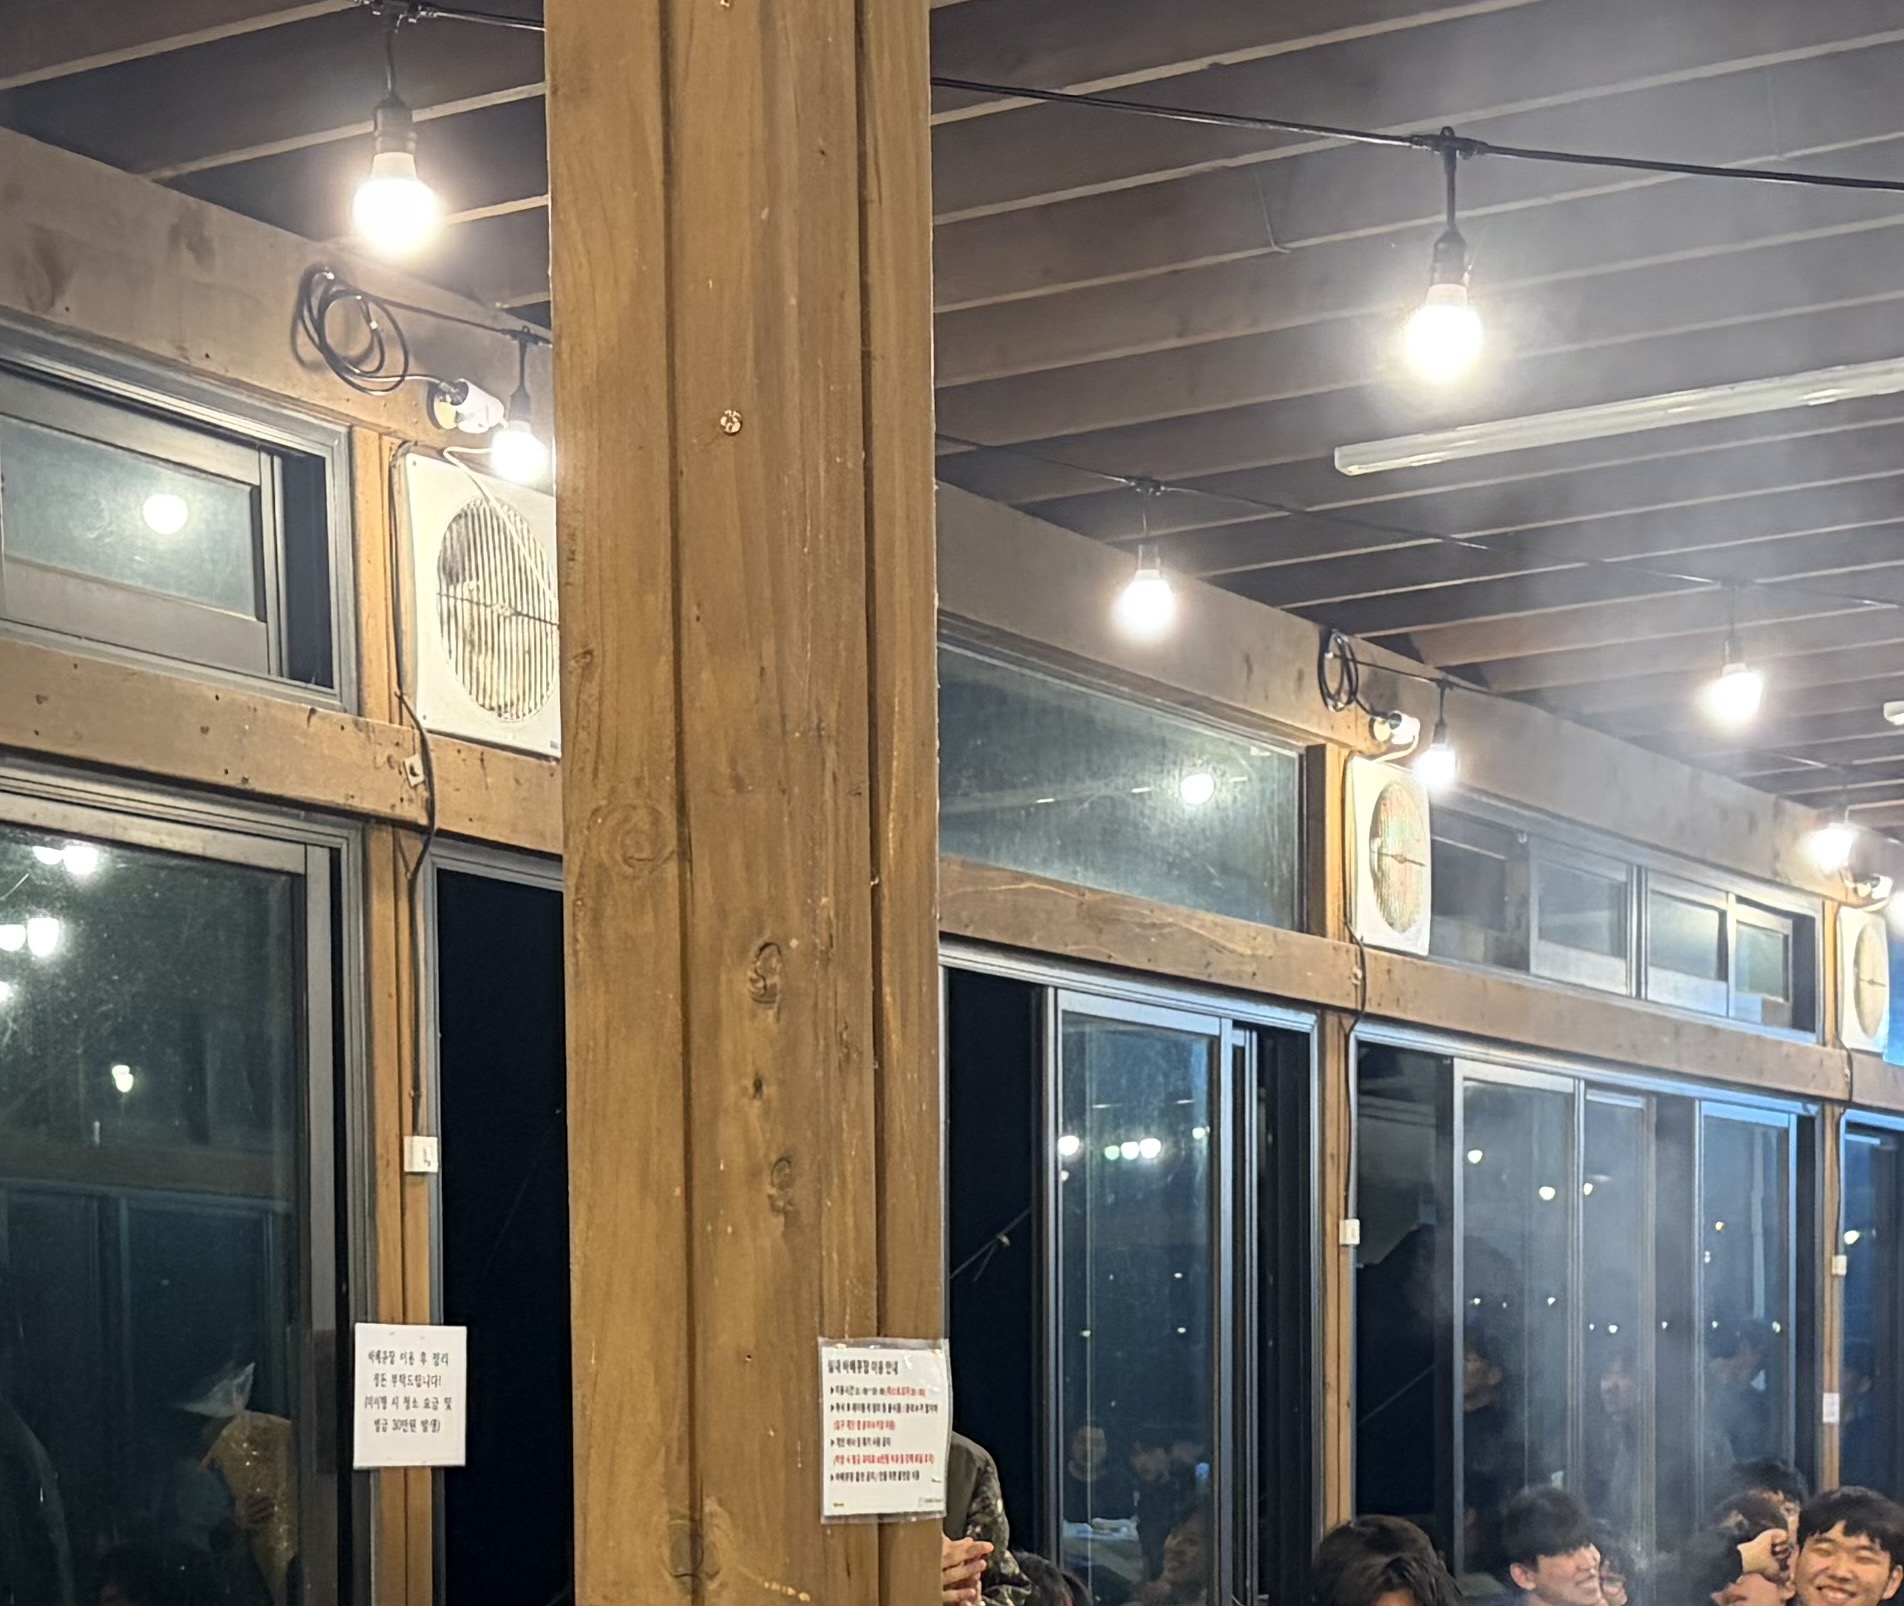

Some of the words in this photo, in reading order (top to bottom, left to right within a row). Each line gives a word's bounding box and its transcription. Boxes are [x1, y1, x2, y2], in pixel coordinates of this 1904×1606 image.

[400, 1351, 415, 1366] 이용
[420, 1351, 427, 1366] 후
[432, 1352, 449, 1367] 정리
[403, 1396, 419, 1411] 청소
[423, 1397, 440, 1411] 요금
[444, 1397, 453, 1411] 및
